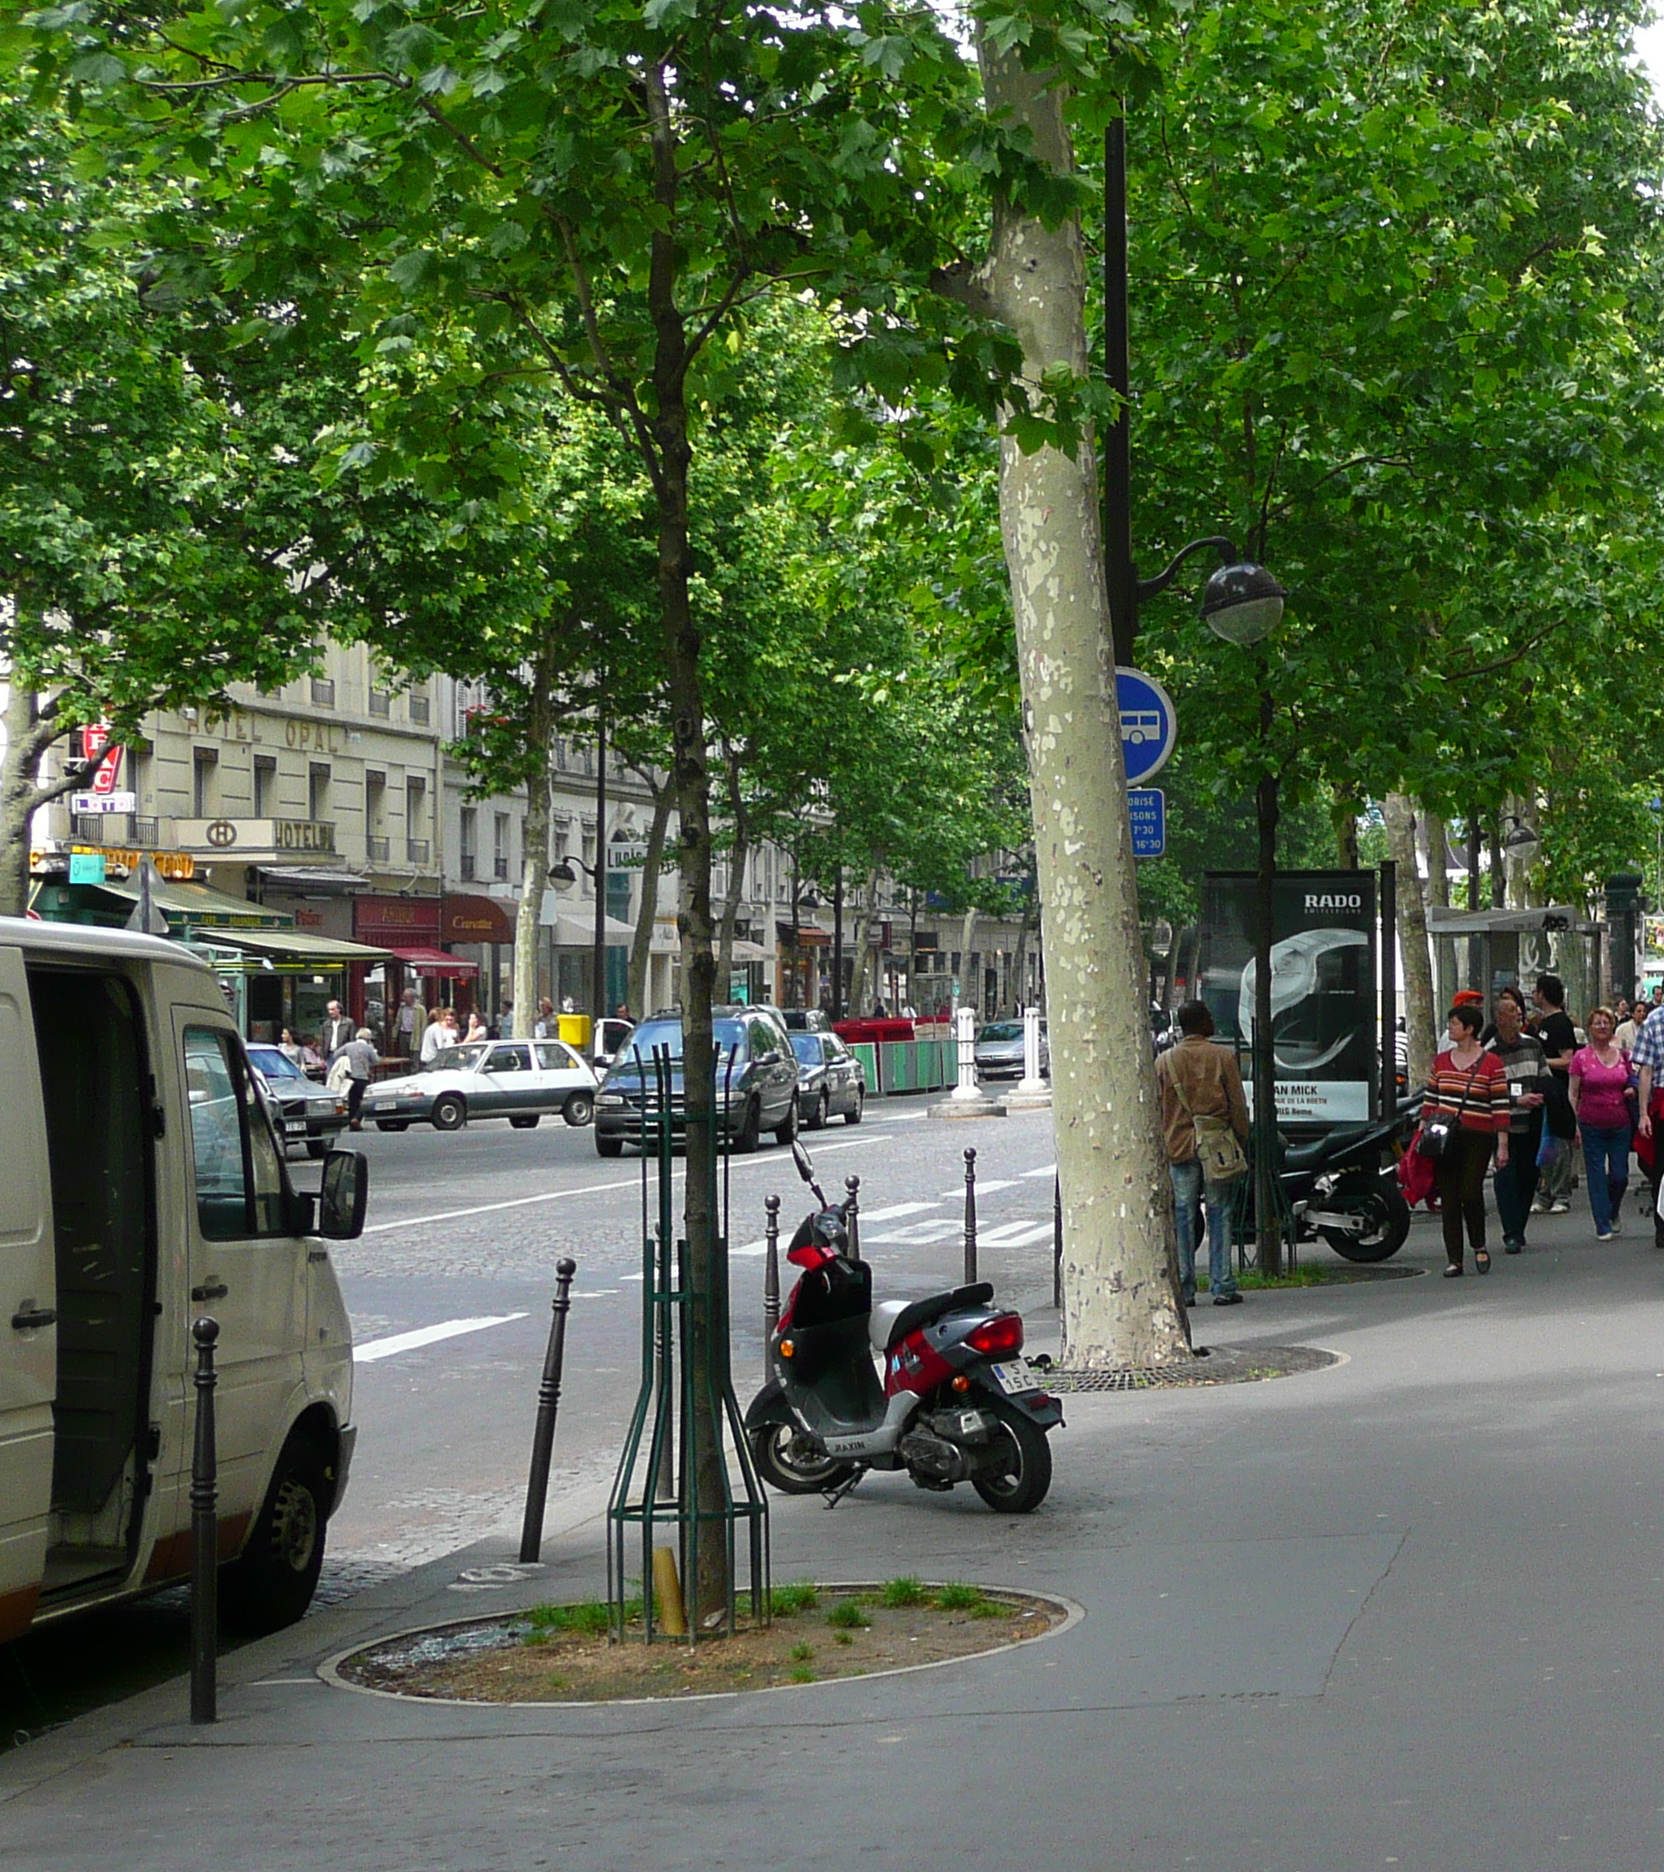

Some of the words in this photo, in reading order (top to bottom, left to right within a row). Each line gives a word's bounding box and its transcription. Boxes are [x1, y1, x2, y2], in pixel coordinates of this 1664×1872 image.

[286, 719, 338, 753] OPAL
[76, 798, 129, 812] LOTO
[275, 821, 320, 849] HOTEL
[1304, 894, 1362, 908] RADO
[1291, 1085, 1318, 1095] MICK
